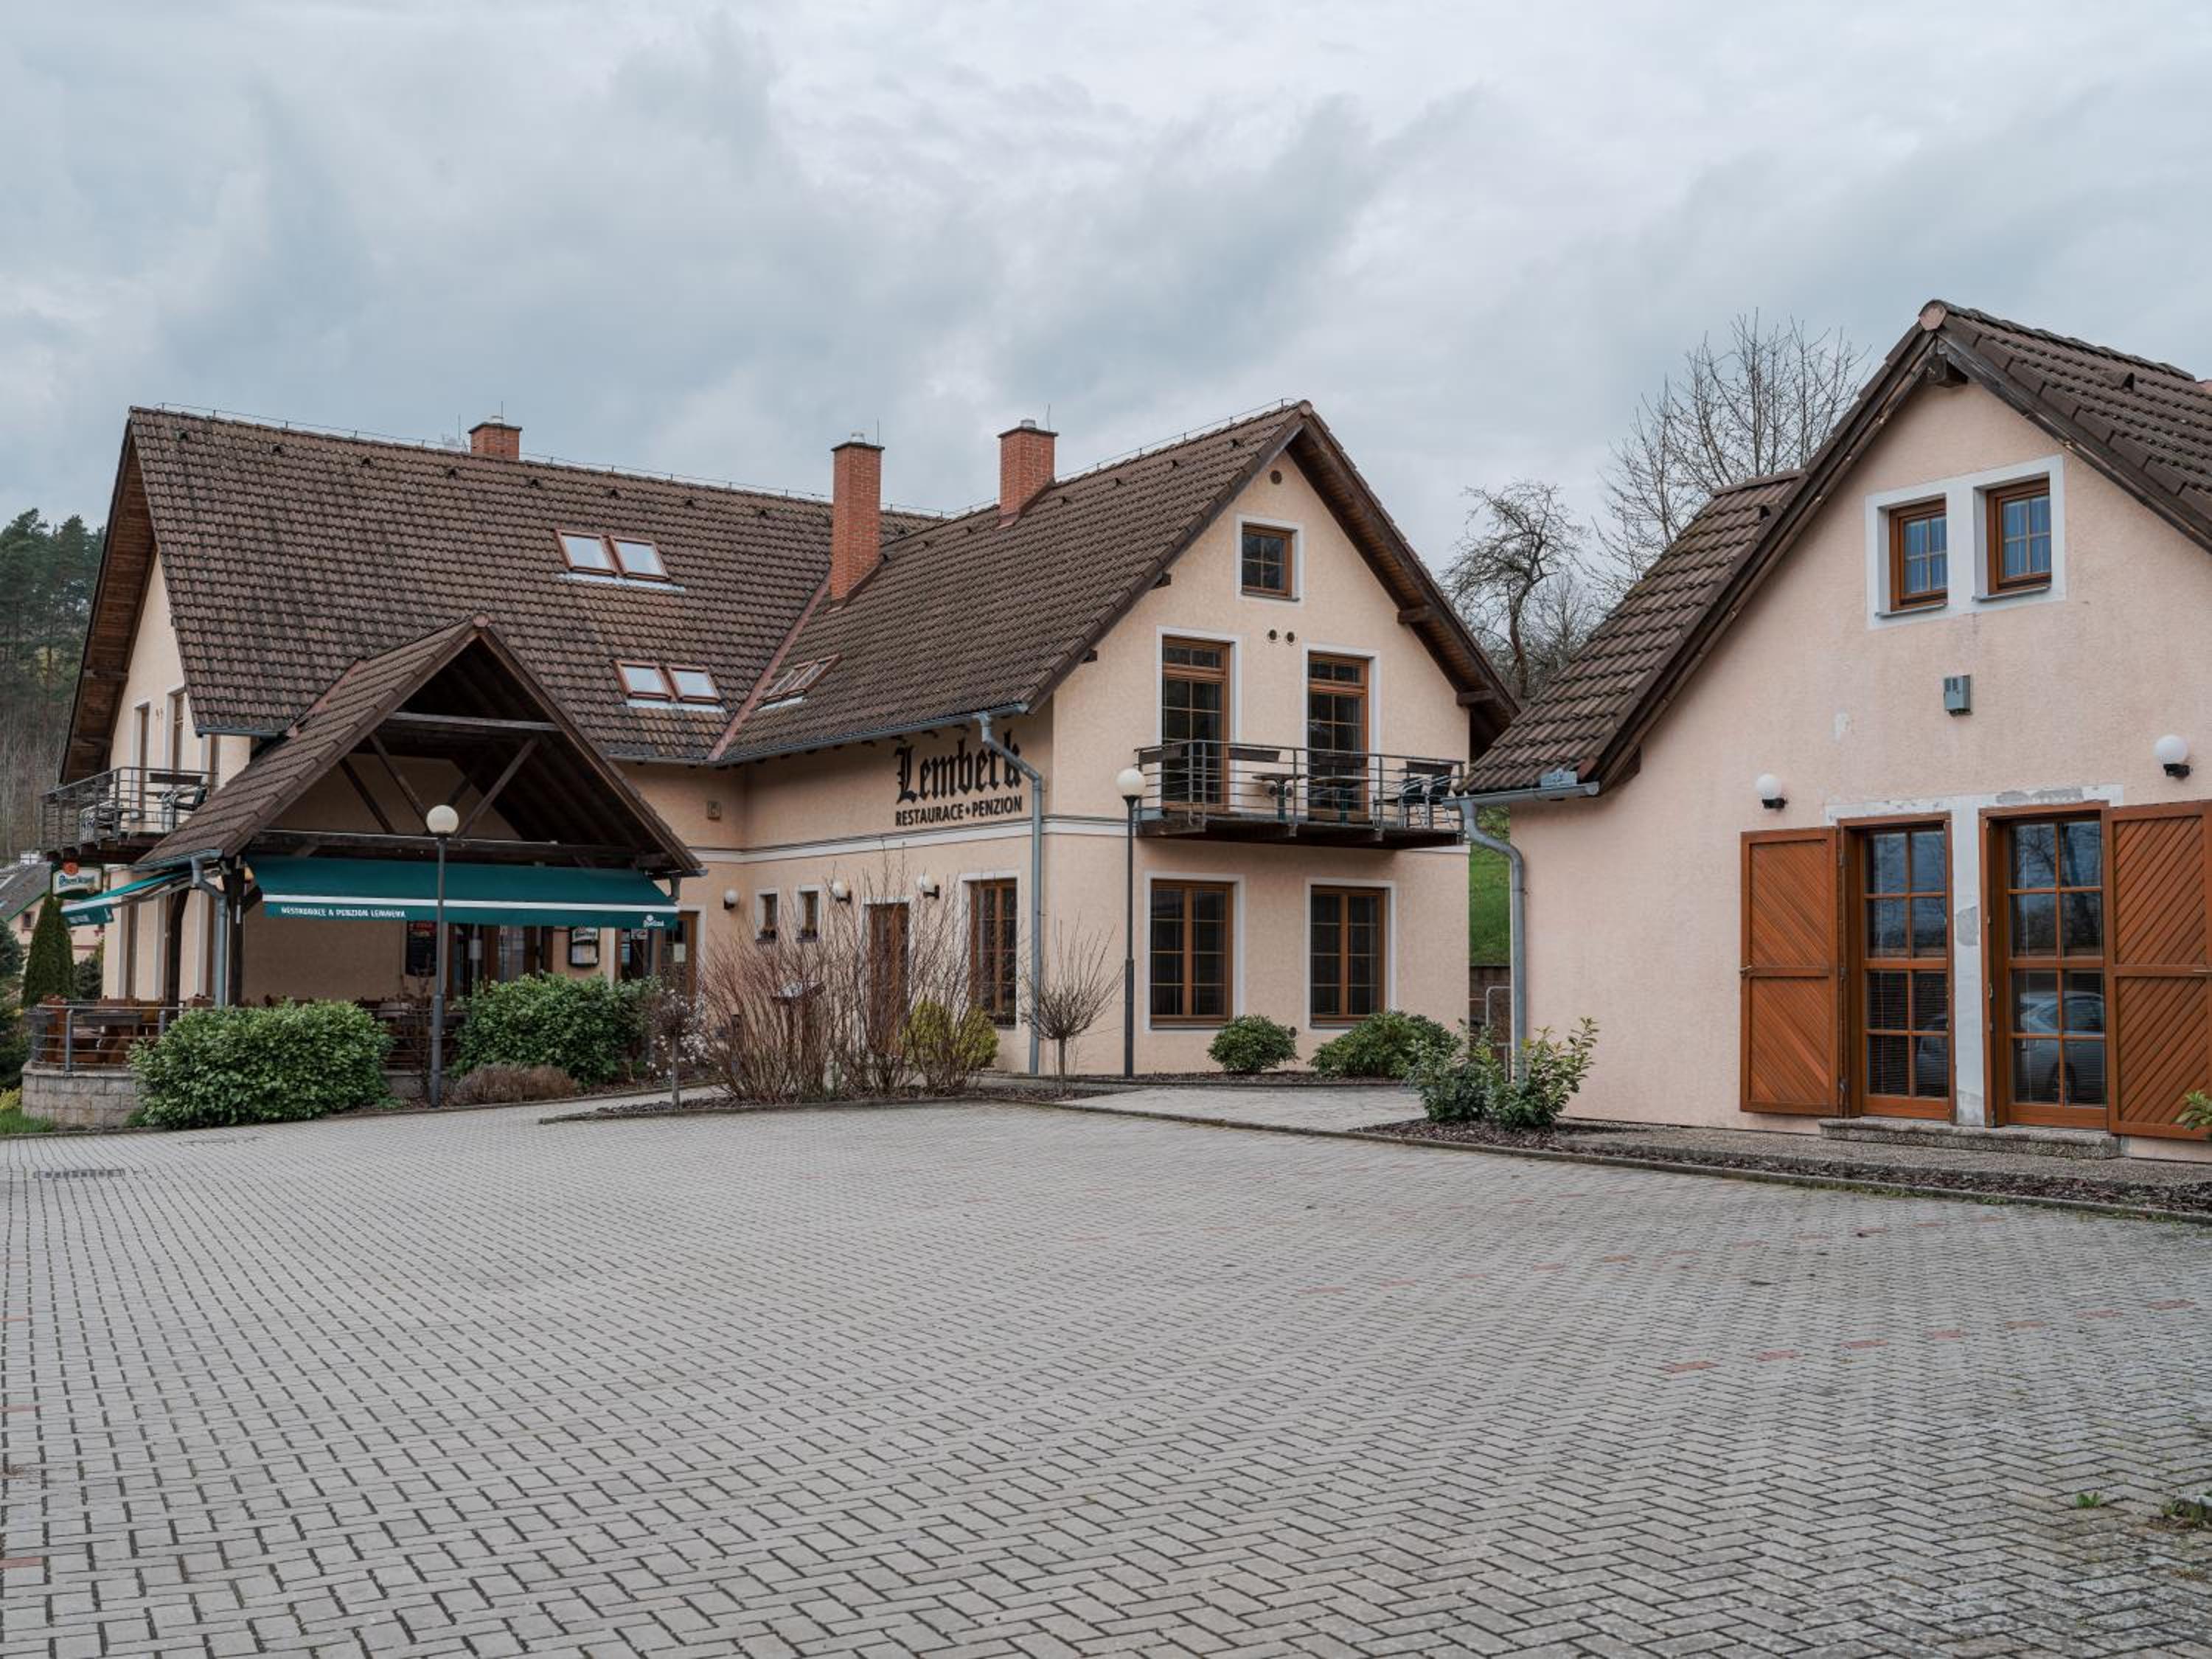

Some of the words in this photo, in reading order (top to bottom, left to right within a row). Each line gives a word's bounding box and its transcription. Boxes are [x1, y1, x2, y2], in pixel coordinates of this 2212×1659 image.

[895, 728, 1022, 804] Lemberk
[895, 803, 964, 827] RESTAURACE
[972, 796, 1023, 818] PENZION
